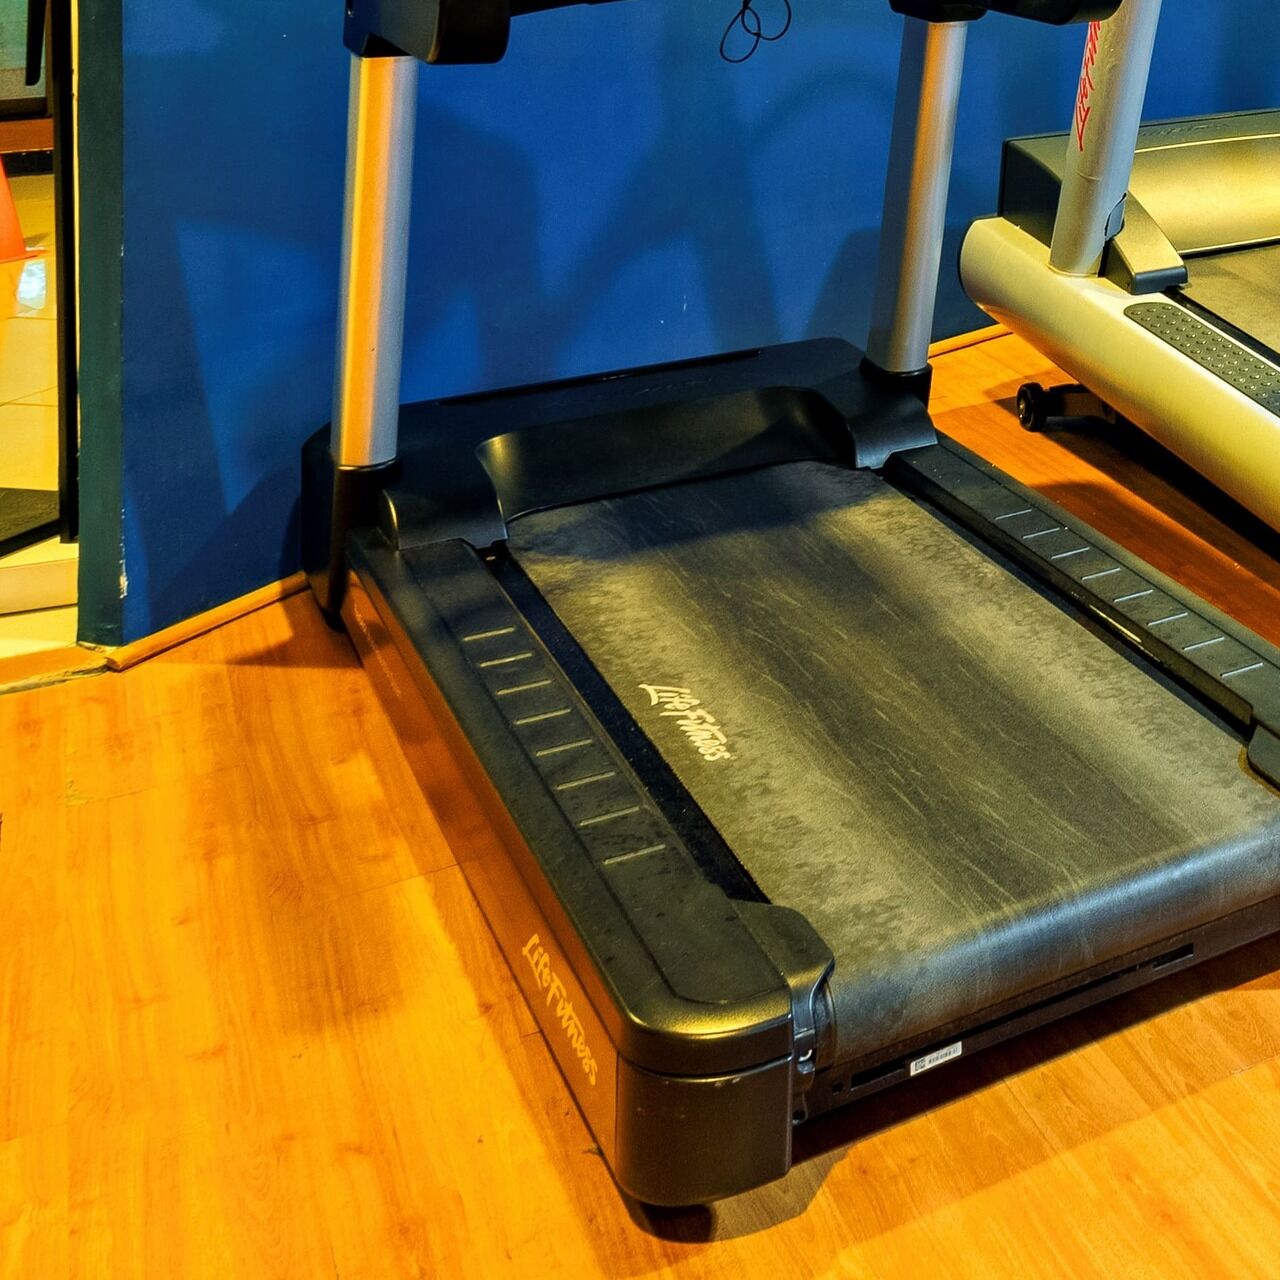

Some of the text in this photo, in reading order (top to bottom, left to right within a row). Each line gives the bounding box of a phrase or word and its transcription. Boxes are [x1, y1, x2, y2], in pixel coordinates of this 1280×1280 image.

[638, 683, 731, 762] Life Fitness
[521, 933, 599, 1086] Life Fitness
